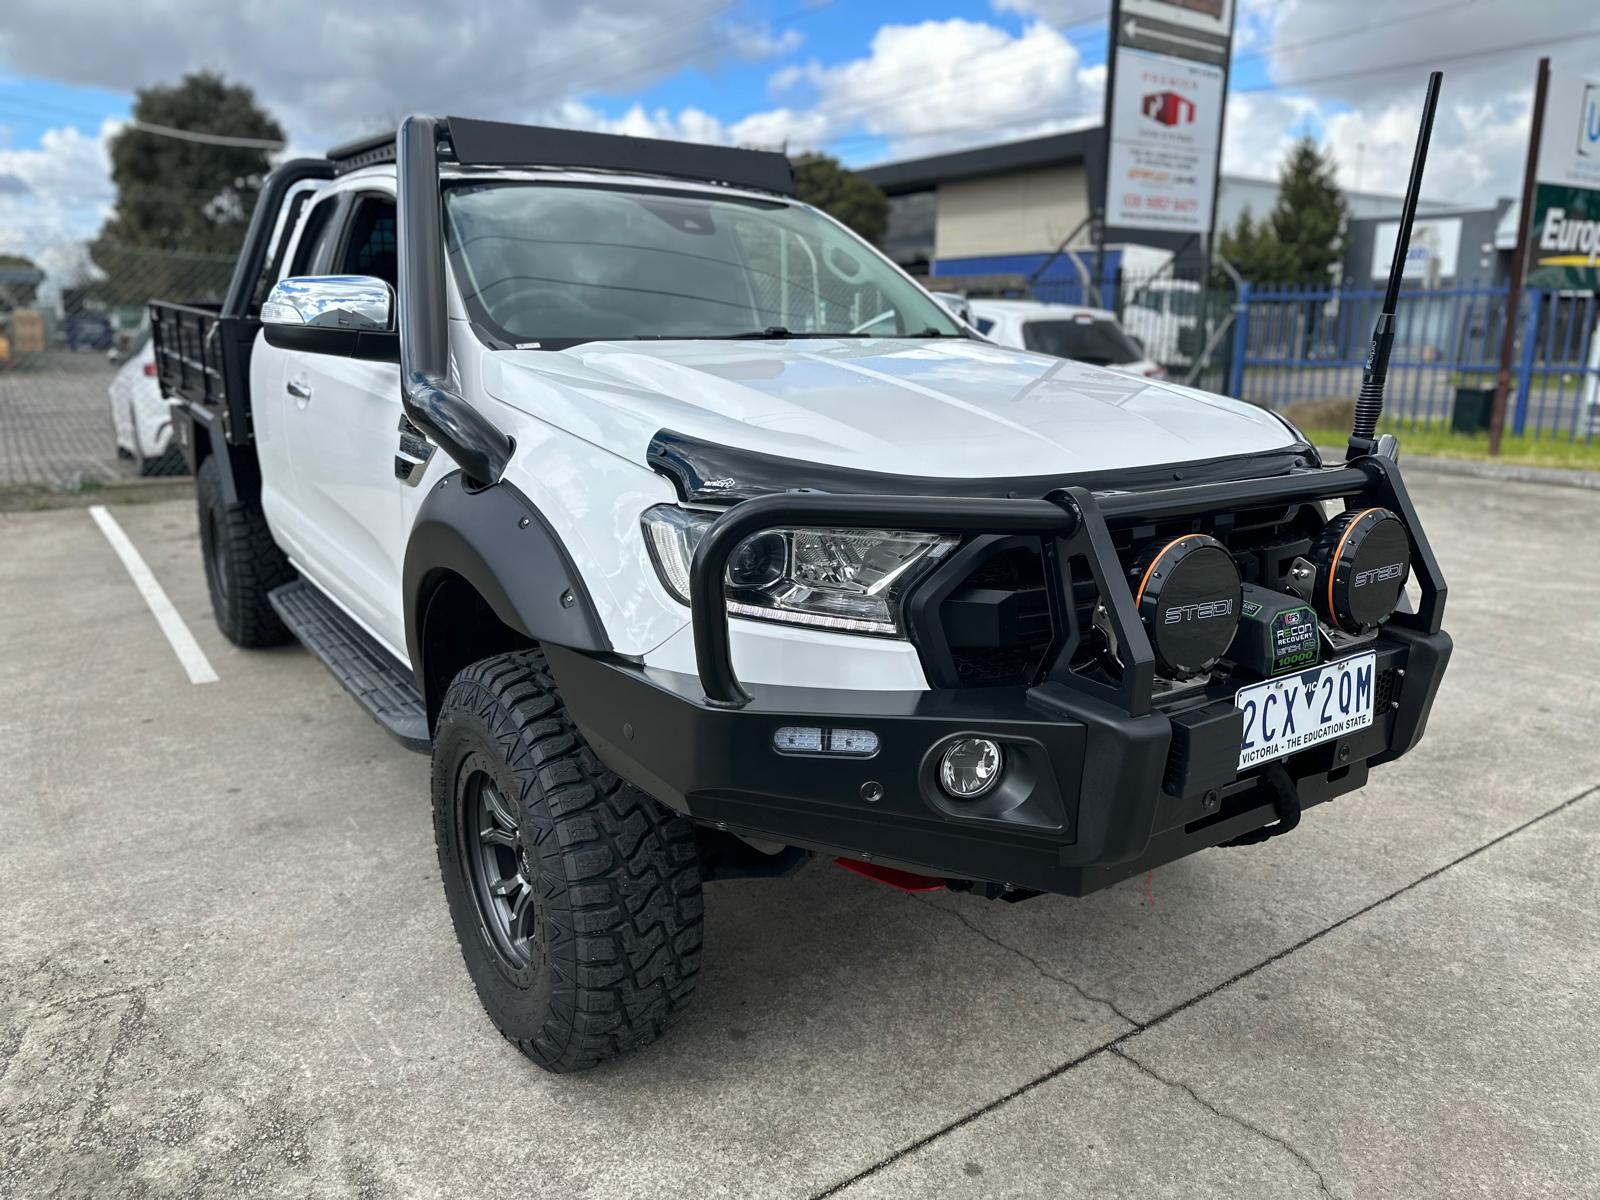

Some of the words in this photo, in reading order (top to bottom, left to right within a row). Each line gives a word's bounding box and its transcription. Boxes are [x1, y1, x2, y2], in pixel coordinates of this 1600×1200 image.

[1355, 563, 1403, 587] STEDI
[1165, 599, 1232, 624] STEDI
[1278, 632, 1313, 645] RECOVERY
[1279, 651, 1313, 666] 10000
[1304, 681, 1318, 693] VIC
[1241, 686, 1299, 751] 2CX
[1319, 664, 1372, 725] 2QM
[1242, 743, 1279, 764] VICTORIA
[1286, 735, 1302, 750] THE
[1303, 721, 1344, 741] EDUCATION
[1345, 714, 1367, 730] STATE
